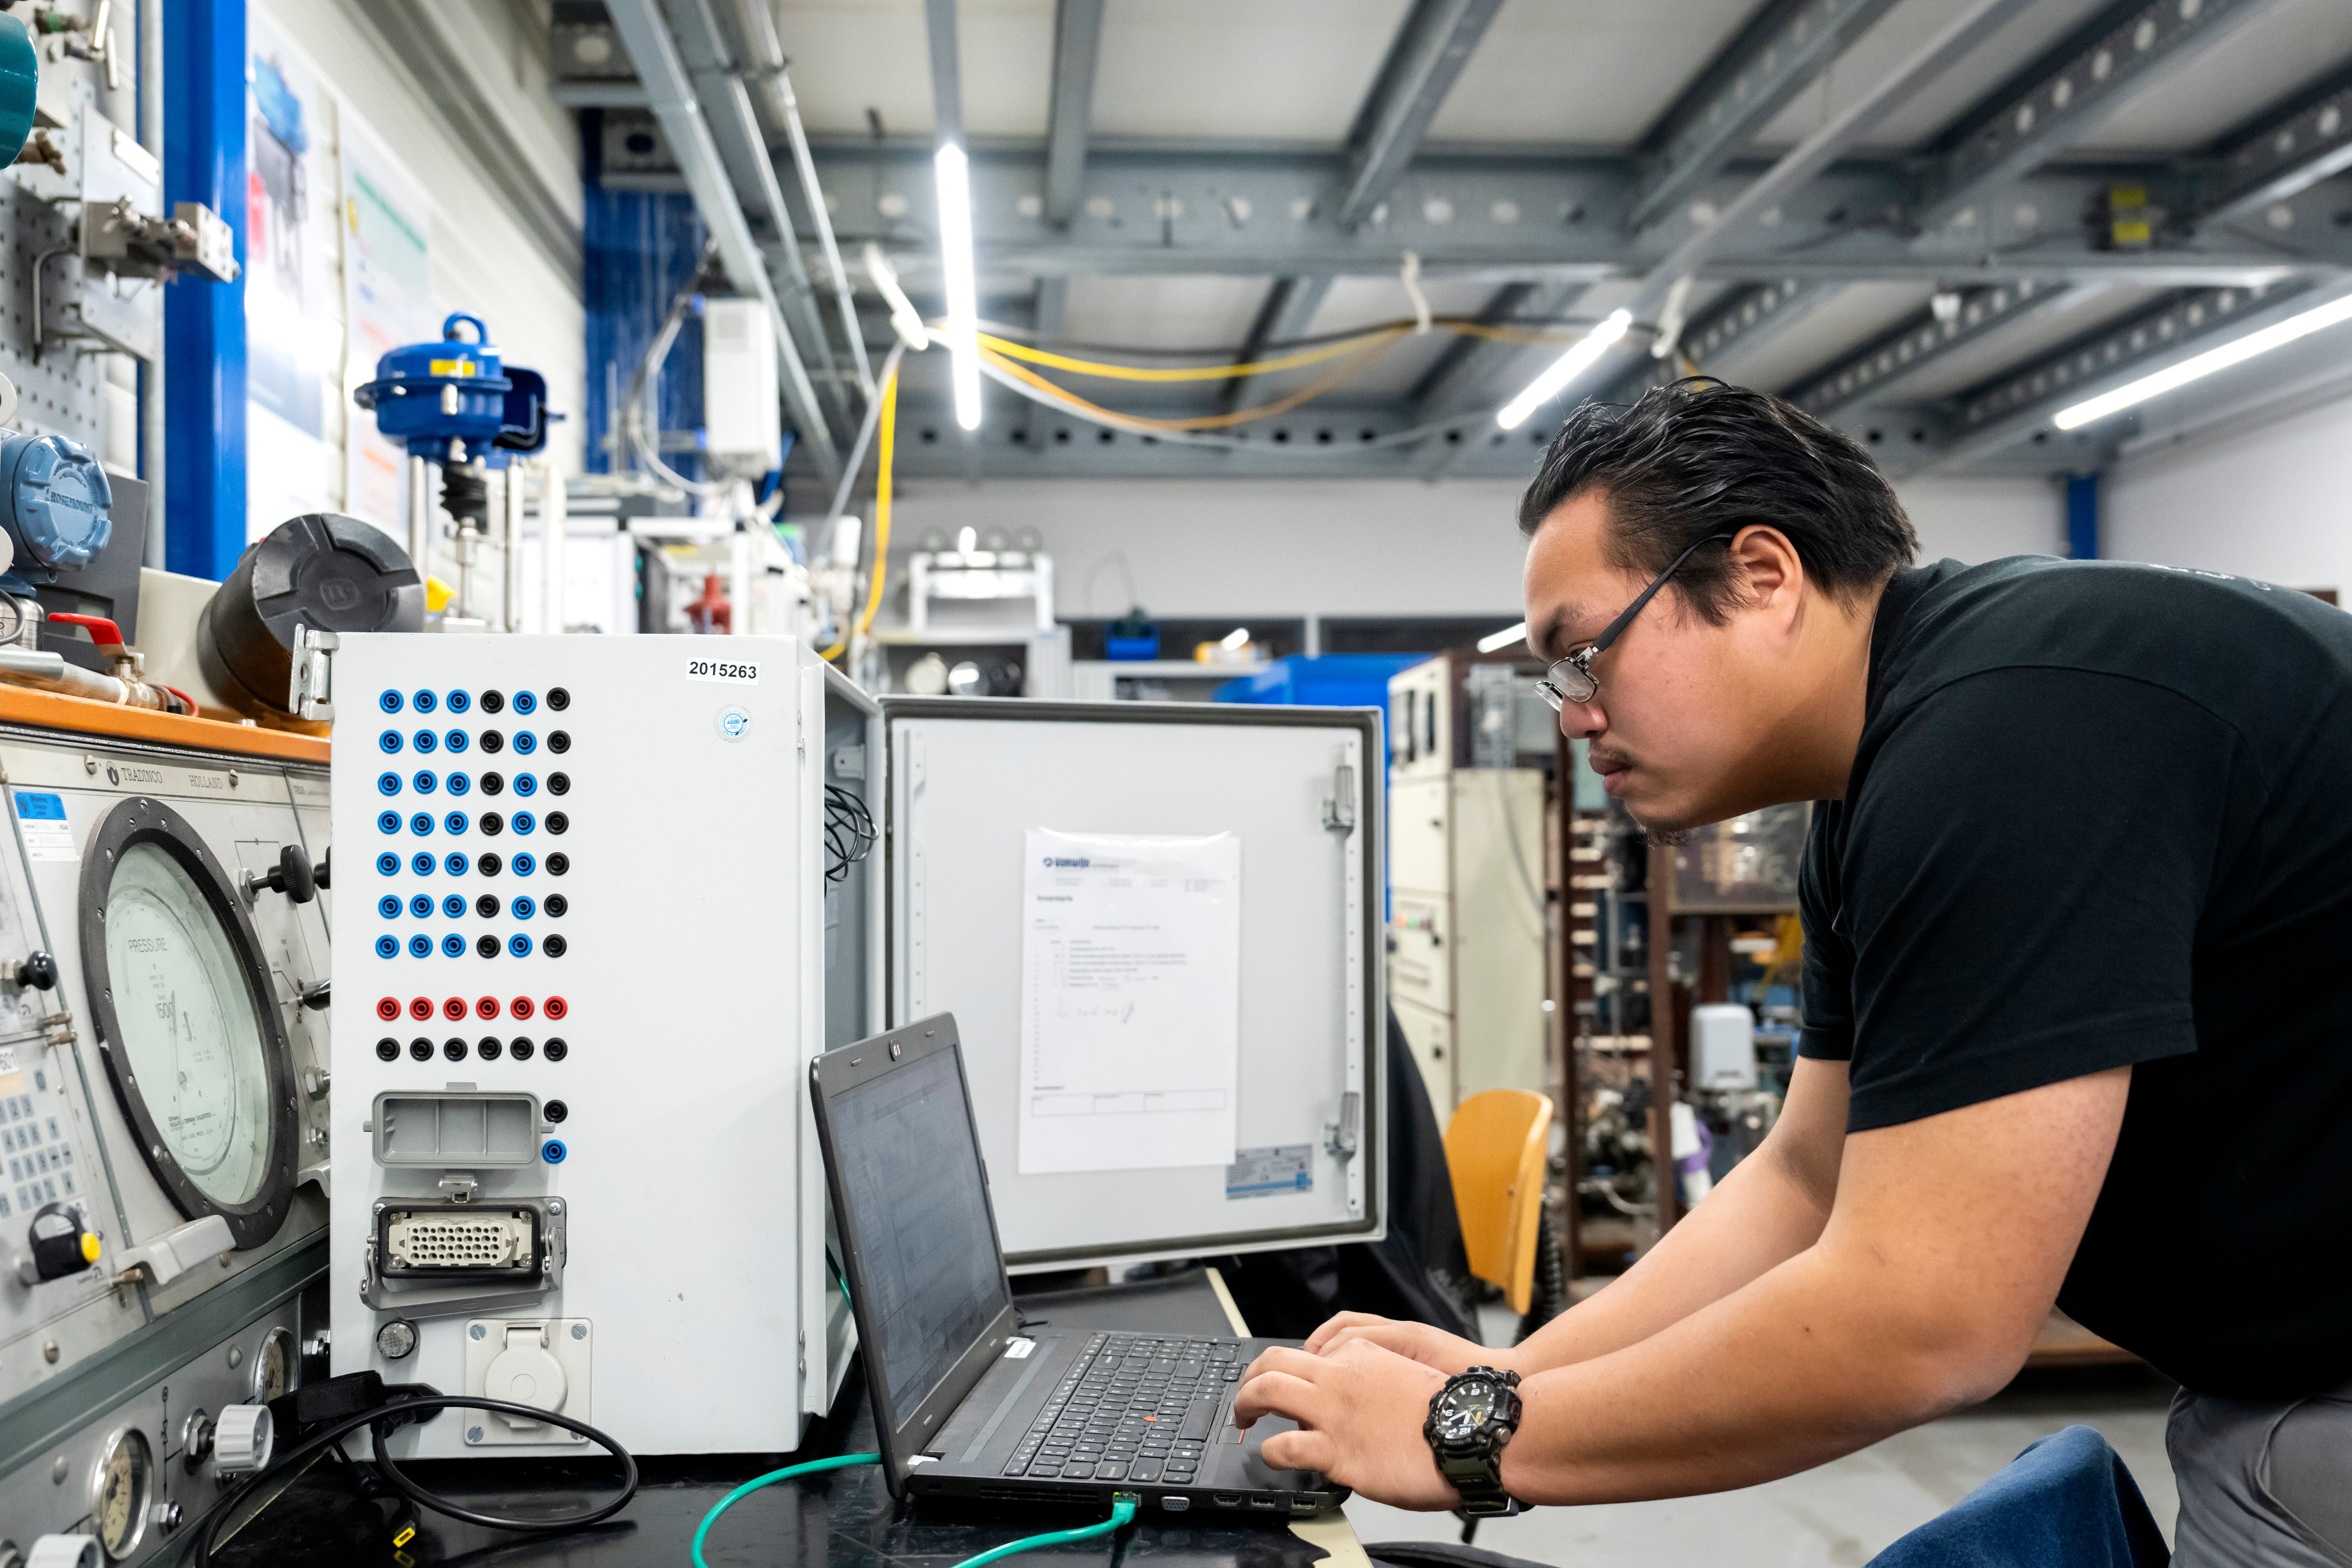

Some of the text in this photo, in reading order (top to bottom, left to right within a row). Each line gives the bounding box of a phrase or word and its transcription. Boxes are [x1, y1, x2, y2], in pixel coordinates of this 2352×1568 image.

[51, 491, 93, 514] ROSEMOUNT
[689, 661, 757, 679] 2015263
[121, 768, 223, 789] TRADINCO HOLLAND
[128, 938, 168, 953] PRESSURE
